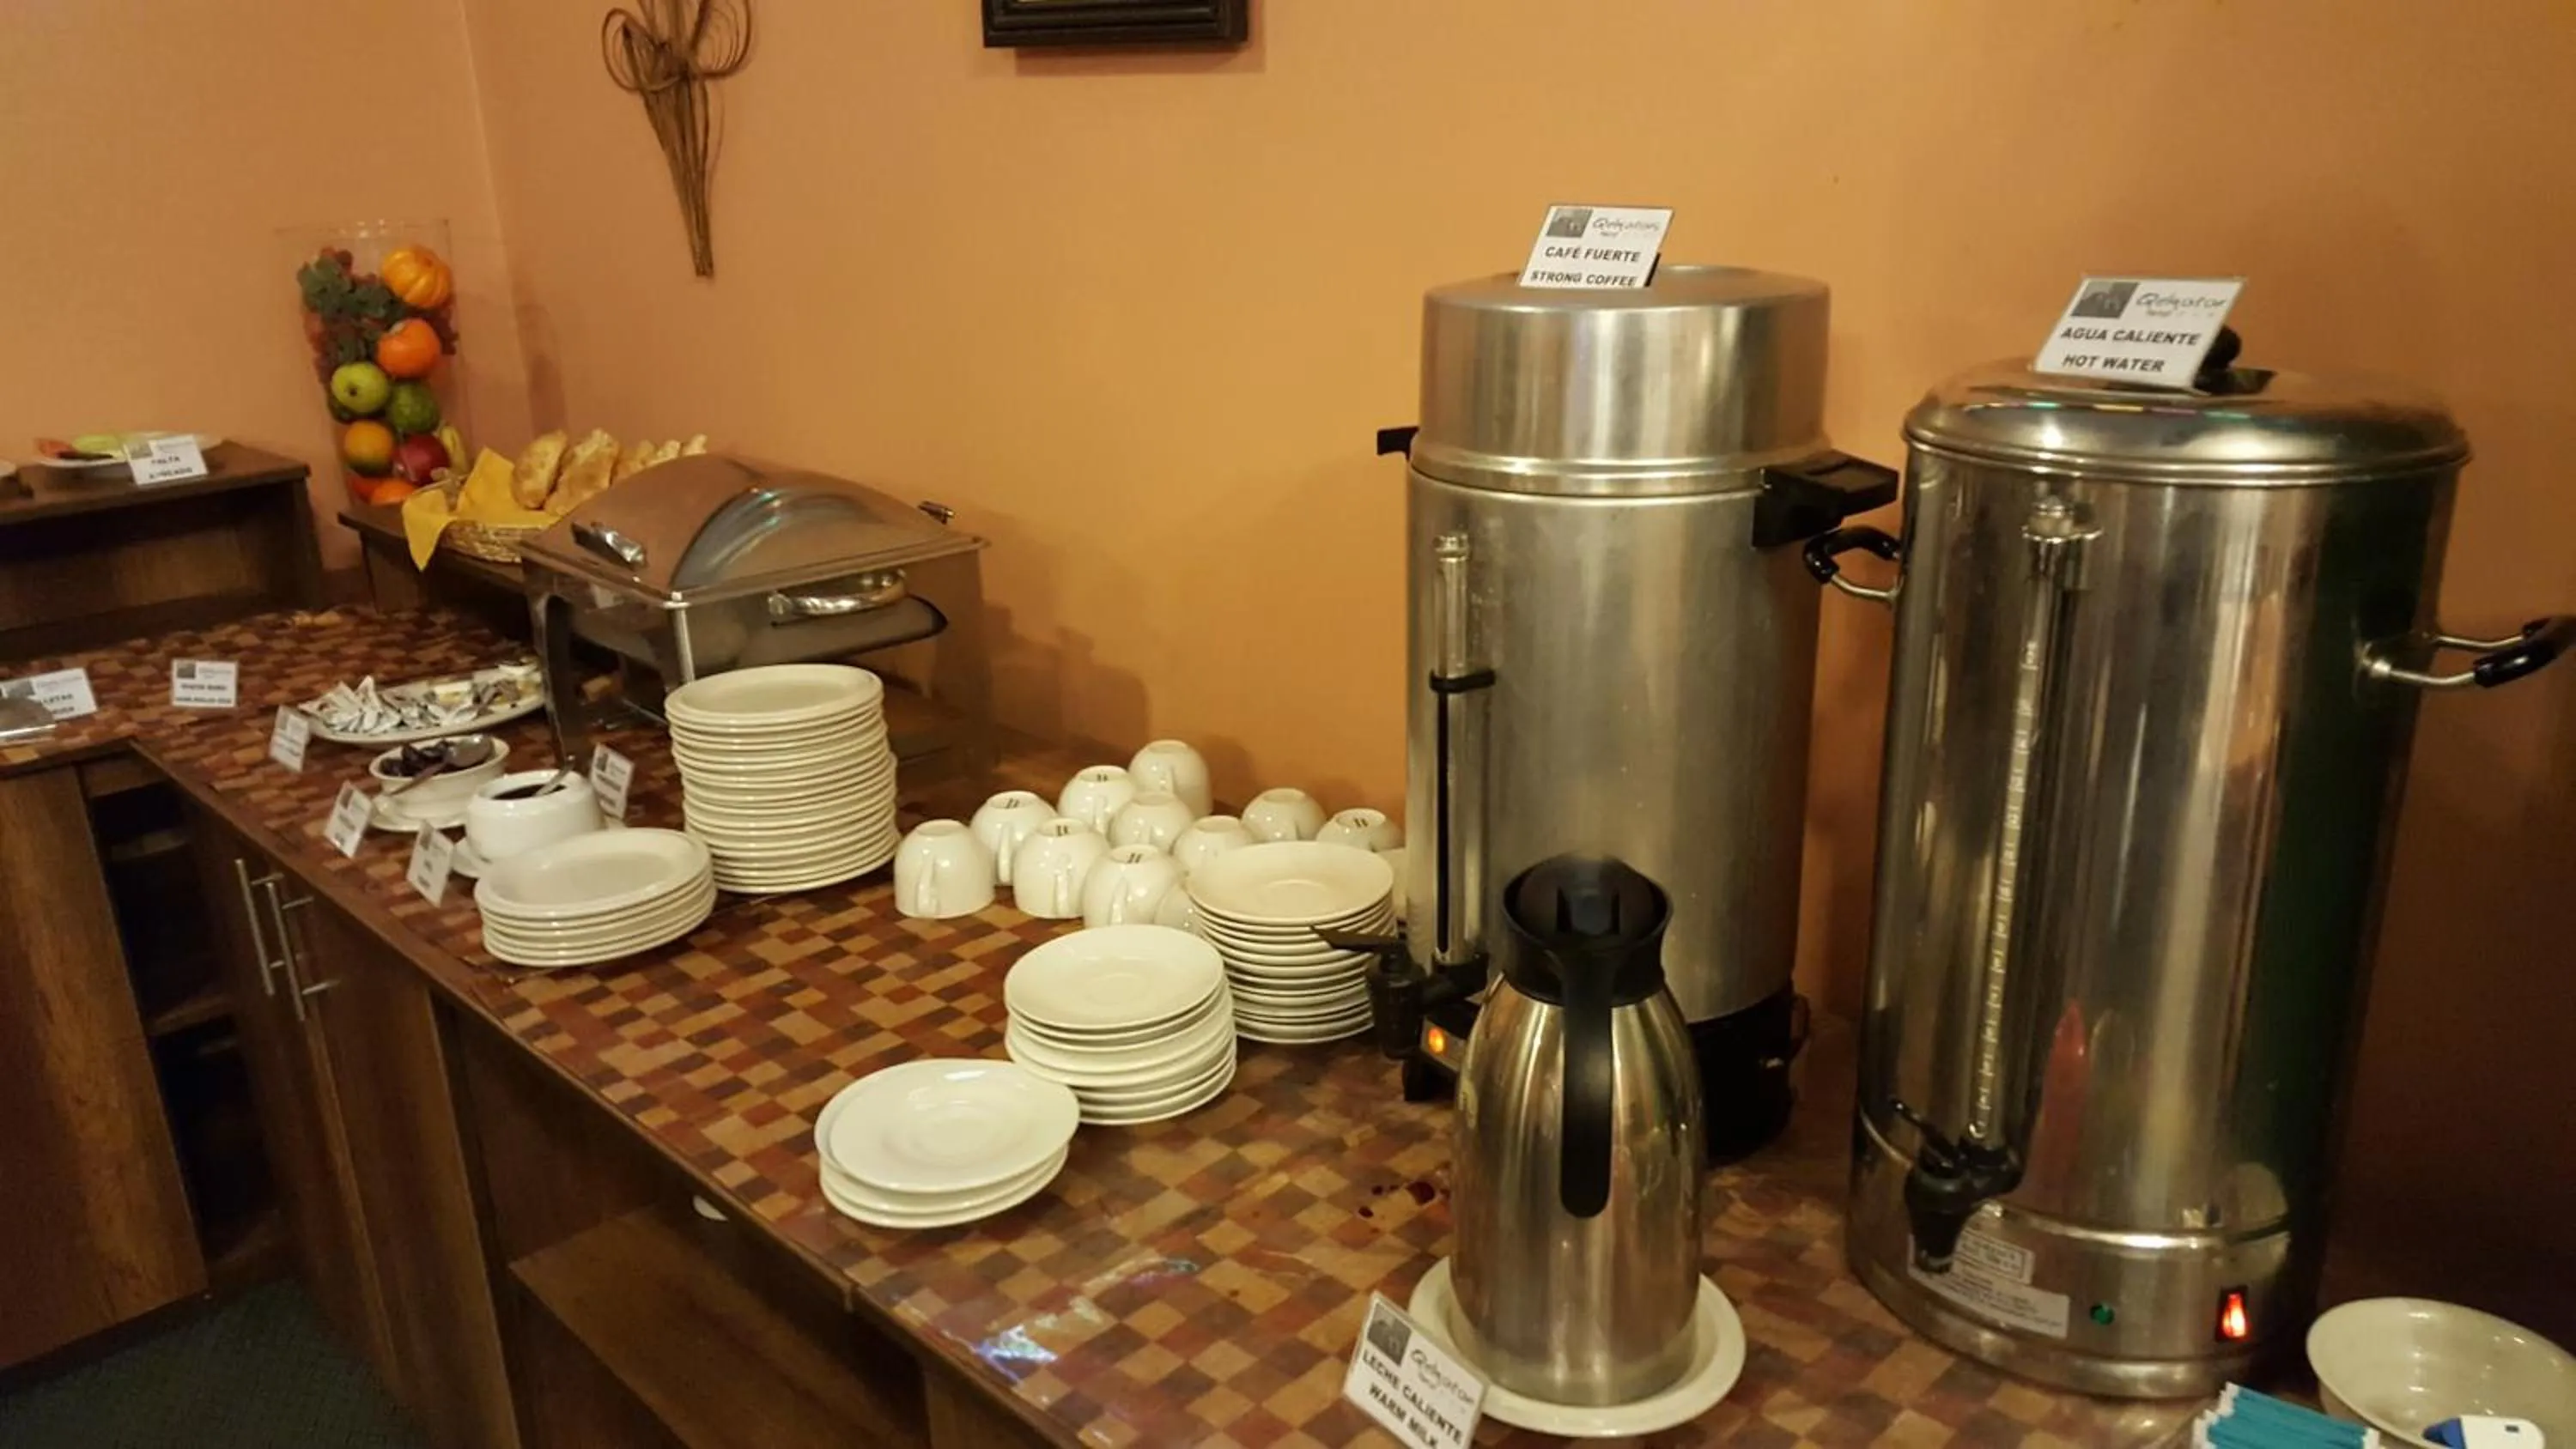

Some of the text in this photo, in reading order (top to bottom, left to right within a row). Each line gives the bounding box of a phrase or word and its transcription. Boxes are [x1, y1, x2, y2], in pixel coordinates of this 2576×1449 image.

[1545, 246, 1642, 262] CAFÉ FUERTE
[1530, 270, 1638, 287] STRONG COFFEE
[2061, 326, 2202, 346] AGUA CALIENTE
[2063, 354, 2166, 373] HOT WATER
[1363, 1349, 1464, 1445] LECHE CALIENTE
[1368, 1382, 1440, 1448] WARM MILK
